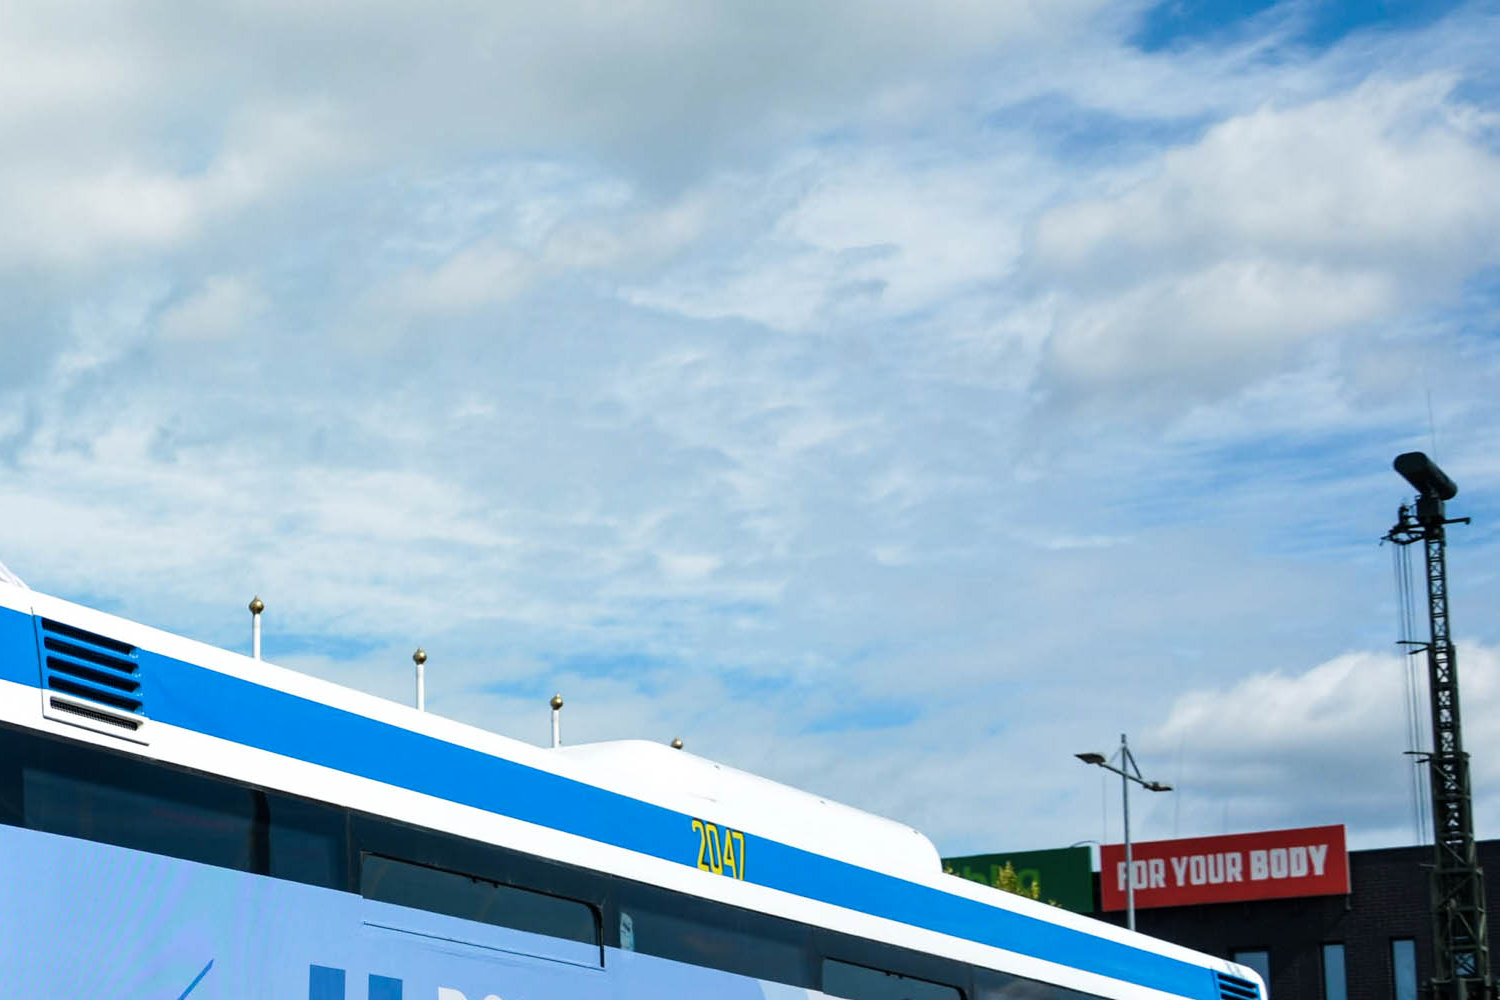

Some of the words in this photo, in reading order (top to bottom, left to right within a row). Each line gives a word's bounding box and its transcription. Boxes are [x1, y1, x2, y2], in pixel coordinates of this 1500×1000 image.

[691, 817, 746, 881] 2047
[1117, 858, 1167, 892] FOR
[1170, 851, 1244, 887] YOUR
[1250, 844, 1329, 882] BODY
